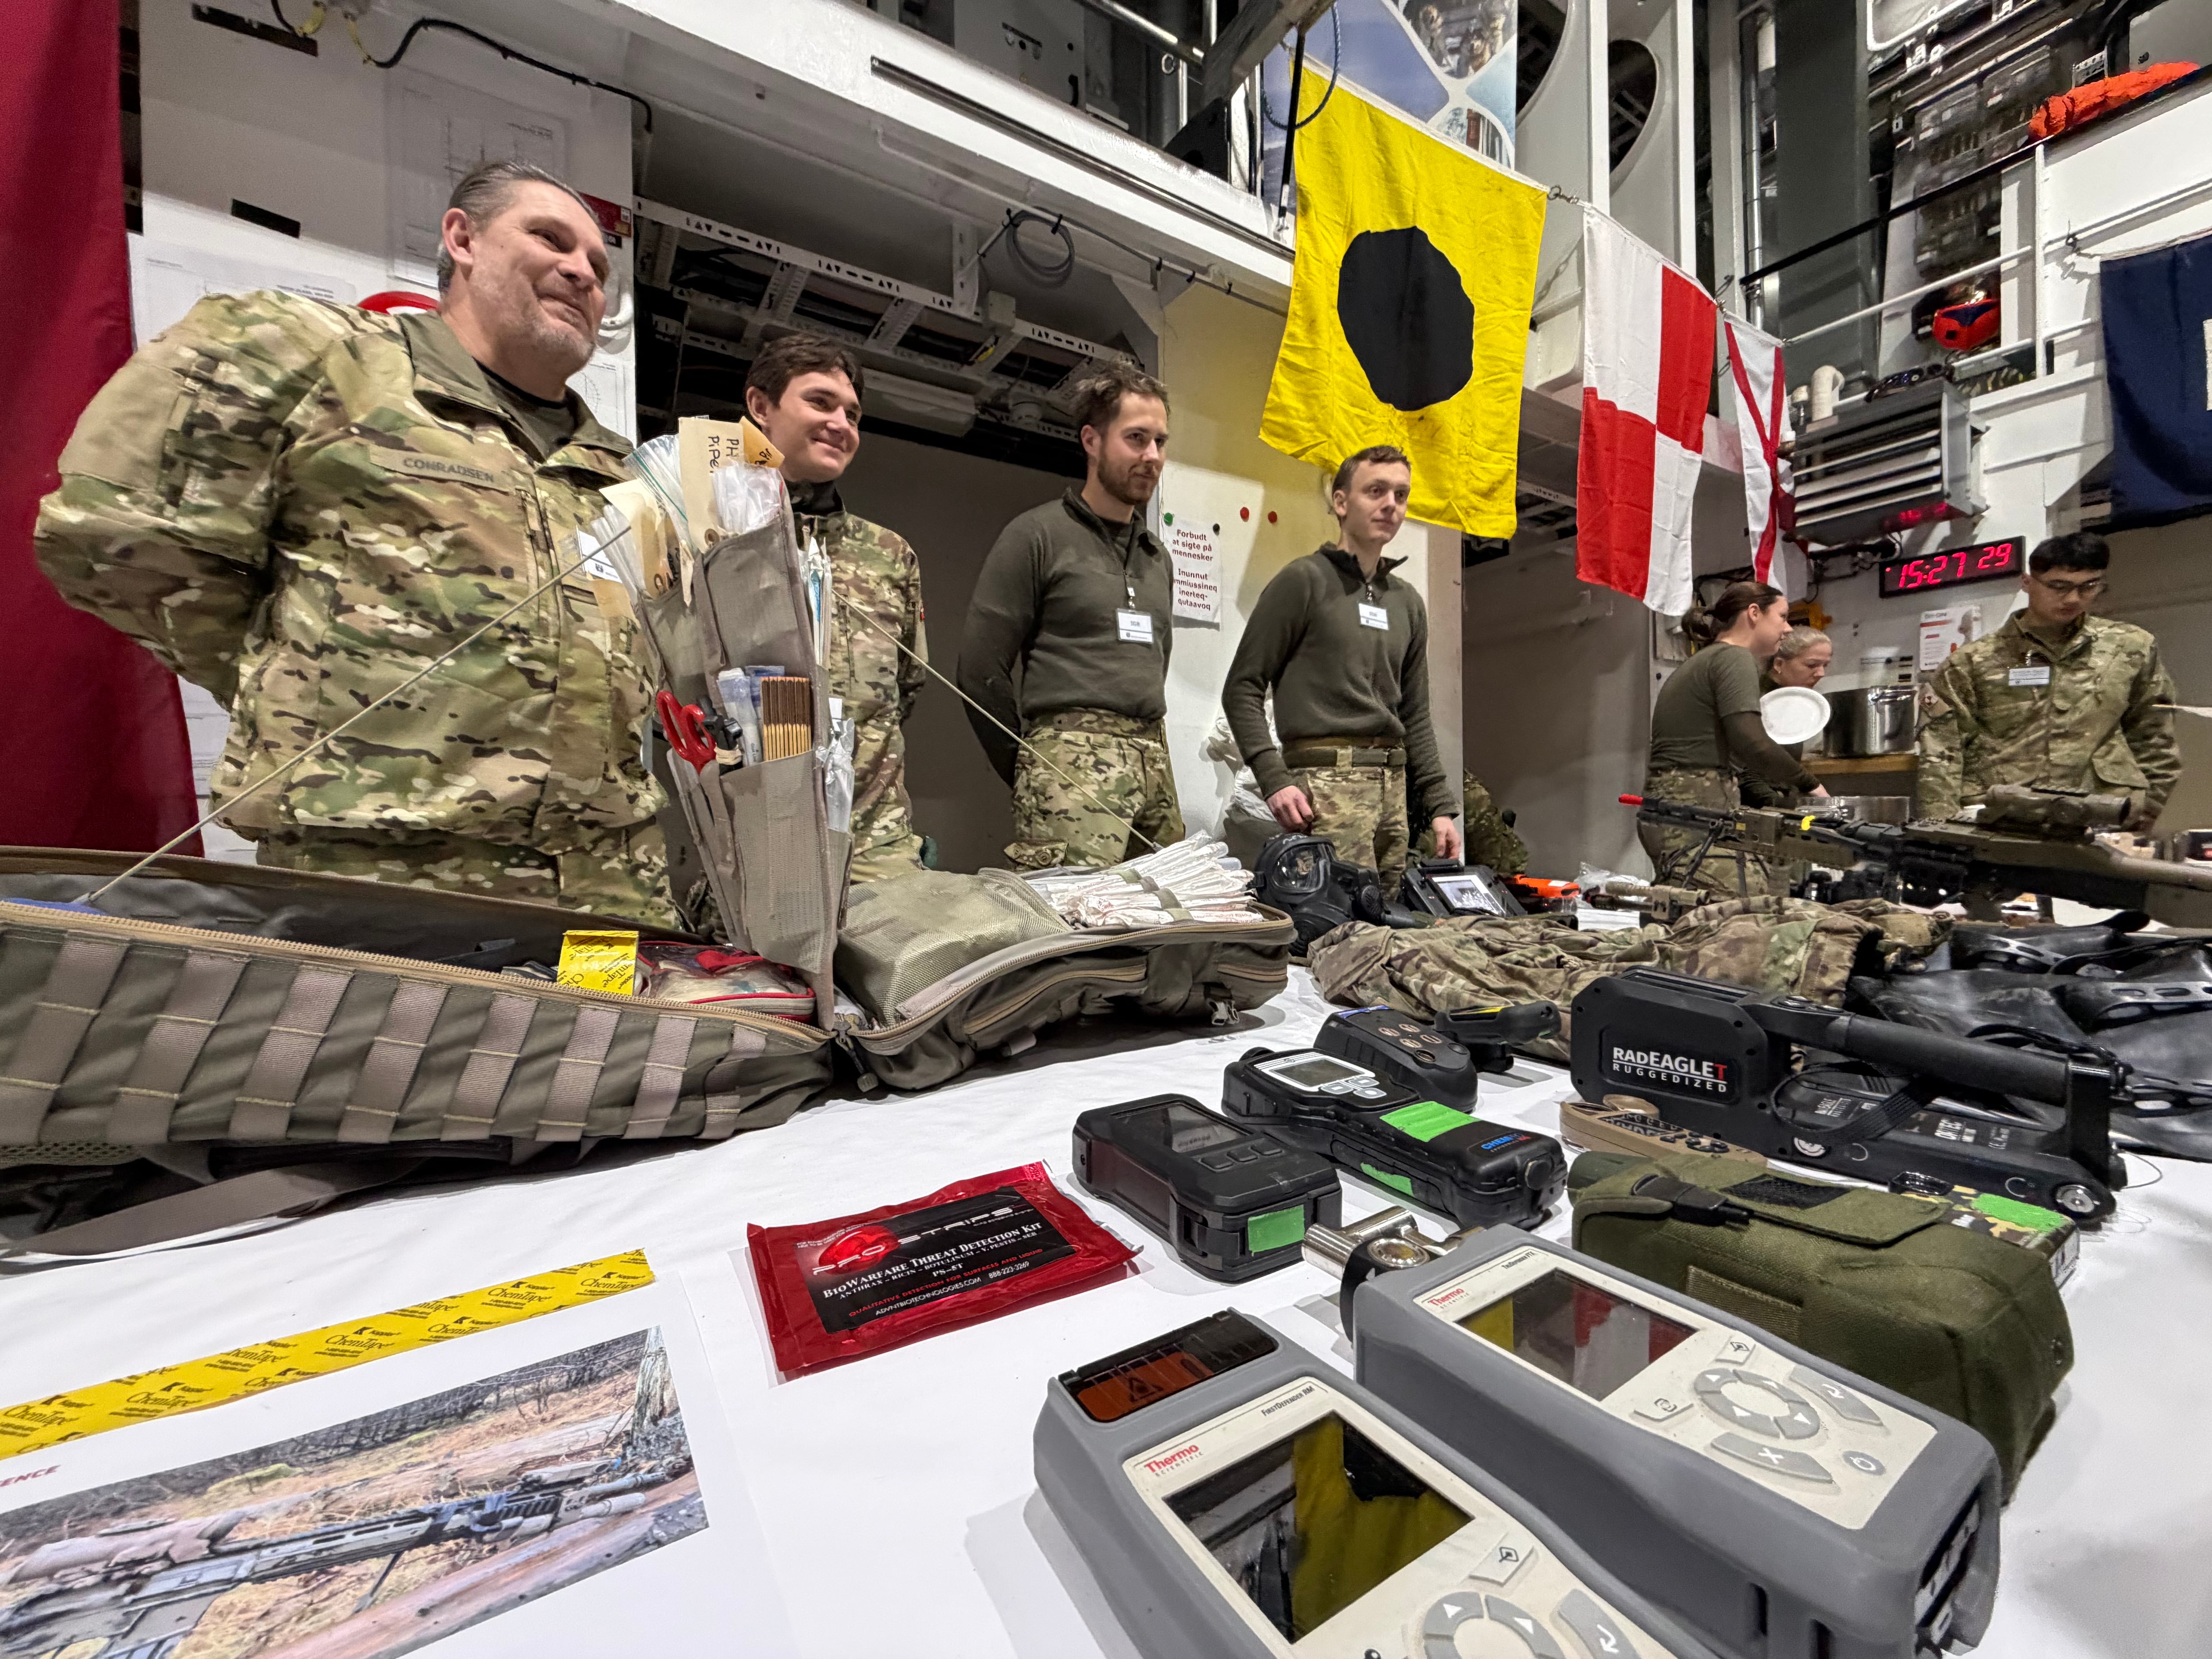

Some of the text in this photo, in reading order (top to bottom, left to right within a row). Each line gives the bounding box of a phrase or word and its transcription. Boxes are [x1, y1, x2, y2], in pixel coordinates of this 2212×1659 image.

[1177, 529, 1207, 541] Forbudt
[1181, 540, 1201, 550] sigte
[1172, 549, 1214, 562] mennesker
[1899, 543, 2012, 588] 15:27 29
[1613, 1046, 1728, 1081] RADEAGLET
[1613, 1063, 1727, 1092] RUGGEDIZED
[910, 1248, 956, 1267] THREAT
[959, 1229, 1020, 1253] DETECTION
[1021, 1222, 1043, 1235] KIT
[840, 1279, 883, 1300] ANTHRAX
[891, 1268, 917, 1281] RICIN
[925, 1251, 975, 1271] BOTULINUM
[990, 1238, 1017, 1250] PESTIS
[1022, 1231, 1037, 1240] SEB
[849, 1294, 900, 1317] QUALITATIVE
[902, 1280, 945, 1297] DETECTION
[946, 1274, 962, 1283] FOR
[963, 1262, 999, 1277] SURFACES
[1019, 1248, 1043, 1260] LIQUID
[1428, 1288, 1465, 1306] Thermo
[1302, 1385, 1315, 1396] RM
[1144, 1444, 1199, 1473] Thermo
